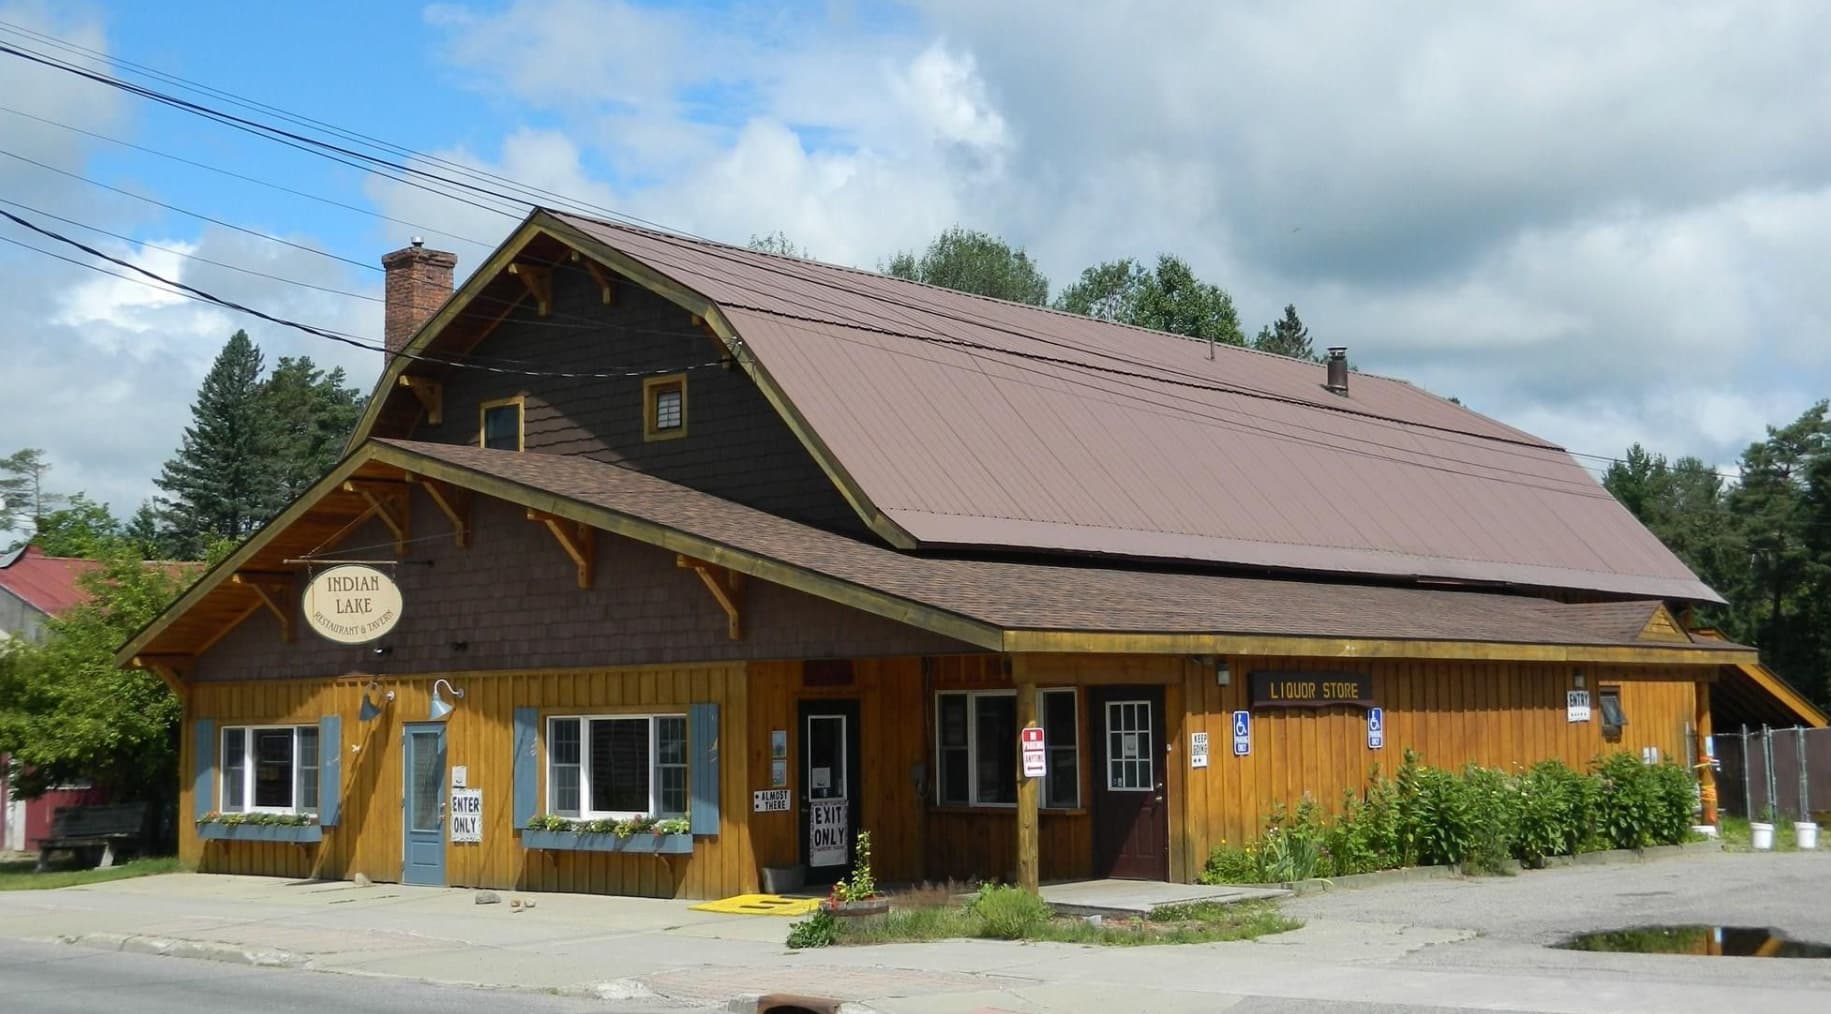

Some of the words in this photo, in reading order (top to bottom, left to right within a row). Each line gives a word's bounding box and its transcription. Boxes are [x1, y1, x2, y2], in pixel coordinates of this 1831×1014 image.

[328, 576, 379, 592] INDIAN
[336, 598, 372, 614] LAKE
[315, 611, 359, 635] RESTAURANT
[367, 609, 394, 632] TAVERN
[1270, 681, 1316, 699] LIQUOR
[1323, 682, 1358, 698] STORE
[761, 790, 788, 801] ALMOST
[453, 796, 480, 812] ENTER
[765, 800, 786, 810] THERE
[815, 806, 842, 824] EXIT
[454, 817, 476, 833] ONLY
[815, 827, 845, 846] ONLY
